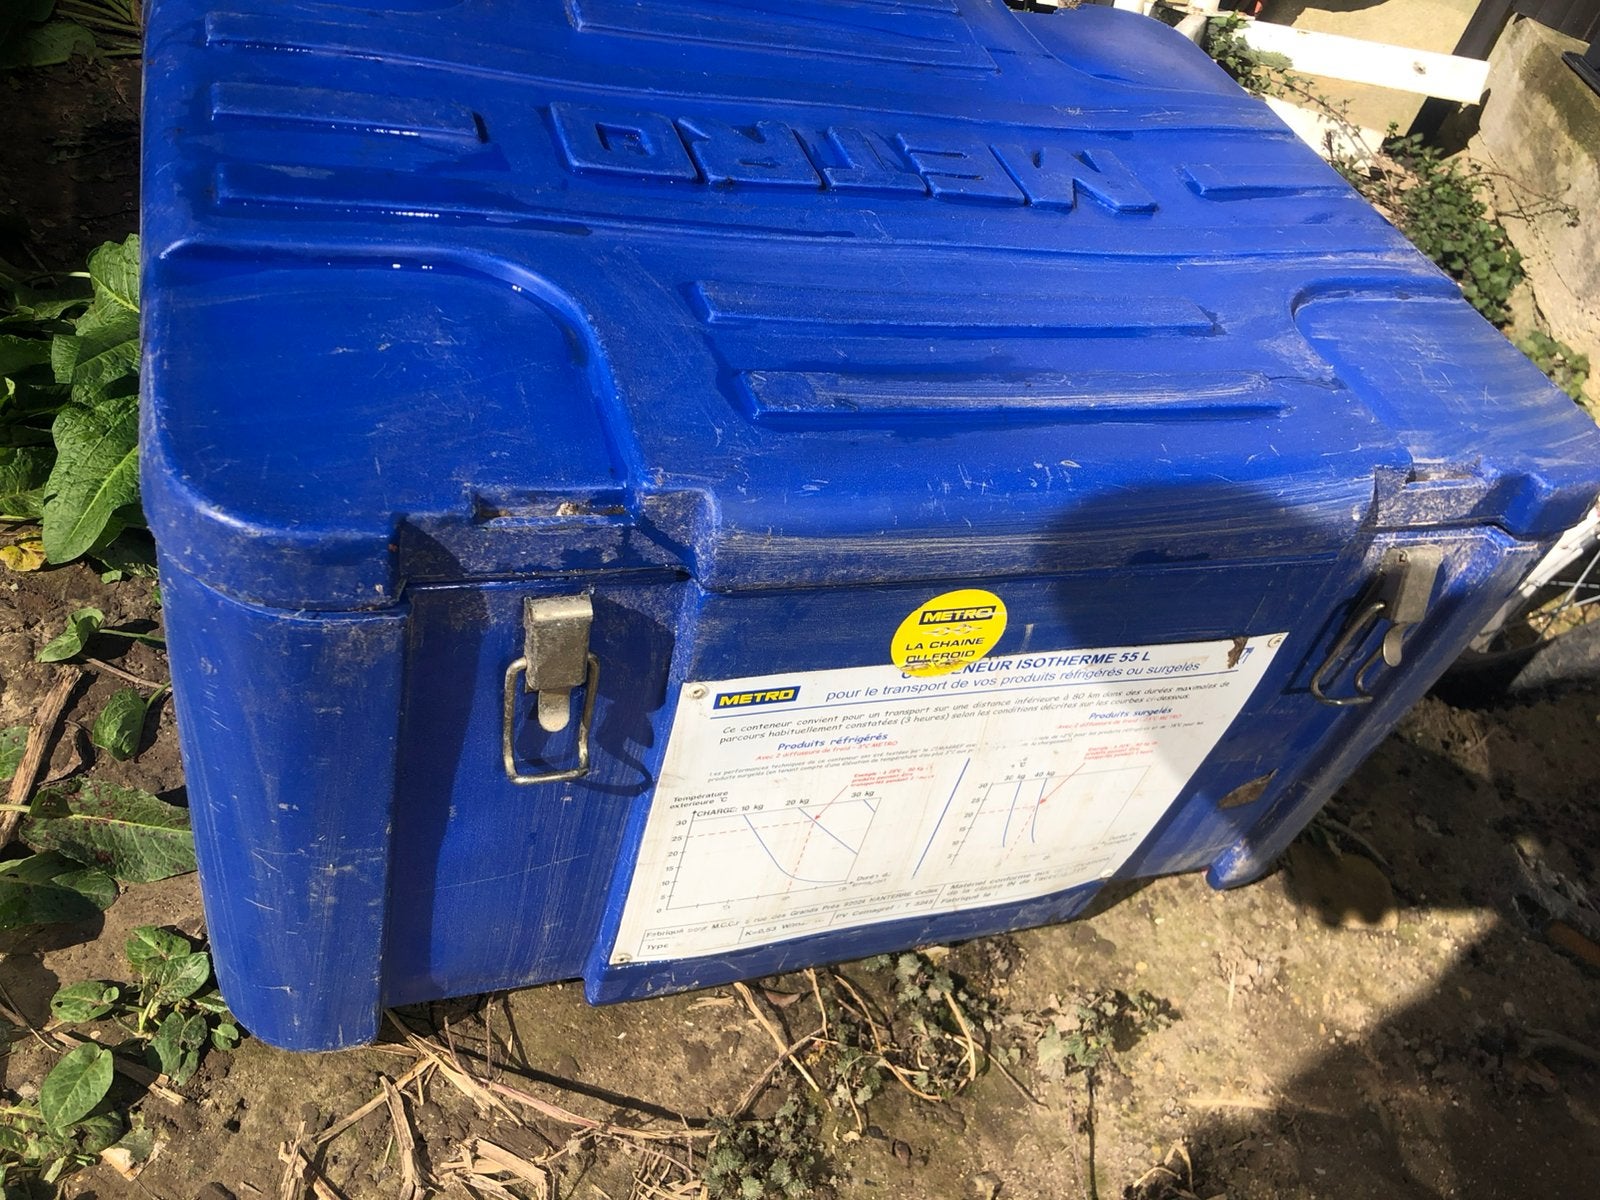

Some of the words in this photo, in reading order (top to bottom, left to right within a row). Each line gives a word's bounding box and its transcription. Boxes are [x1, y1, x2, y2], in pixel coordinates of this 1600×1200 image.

[550, 102, 1158, 214] METRO
[922, 607, 994, 623] METRO
[905, 643, 924, 651] LA
[929, 637, 985, 649] CHAINE
[1016, 652, 1117, 670] ISOTHERME
[1119, 651, 1140, 663] 55
[1142, 651, 1151, 662] L
[826, 688, 861, 702] pour
[865, 686, 878, 697] le
[882, 680, 948, 695] transport
[950, 679, 969, 689] de
[973, 679, 998, 687] vos
[1000, 671, 1057, 689] produits
[1059, 664, 1123, 681] réfrigérés
[1124, 667, 1145, 676] ou
[1145, 661, 1201, 676] surgelés
[718, 688, 796, 707] METRO
[722, 726, 736, 735] Ce
[740, 720, 793, 732] conteneur
[796, 715, 839, 727] convient
[842, 713, 866, 723] pour
[884, 706, 931, 718] transport
[934, 704, 951, 712] sur
[952, 703, 970, 711] une
[972, 699, 1012, 709] distance
[1014, 694, 1061, 705] inférieure
[1063, 693, 1071, 701] à
[1071, 692, 1086, 700] 80
[1087, 691, 1102, 699] km
[1102, 689, 1123, 698] dans
[1125, 688, 1142, 697] des
[1143, 686, 1174, 695] durées
[1218, 680, 1230, 688] de
[1088, 710, 1129, 721] Produits
[1132, 706, 1174, 717] surgelés
[719, 732, 766, 745] parcours
[768, 723, 844, 738] habituellement
[845, 718, 899, 730] constatées
[900, 716, 912, 726] (3
[913, 712, 950, 723] heures)
[951, 708, 976, 719] selon
[977, 708, 991, 717] les
[992, 704, 1039, 716] conditions
[1039, 700, 1078, 711] décrites
[1079, 700, 1095, 708] sur
[1095, 698, 1108, 706] les
[1109, 696, 1145, 706] courbes
[777, 740, 826, 751] Produits
[829, 732, 889, 746] réfrigérés
[673, 790, 730, 803] Température
[784, 799, 798, 807] 20
[798, 797, 811, 807] kg
[863, 789, 876, 799] kg
[741, 804, 751, 812] 10
[753, 803, 765, 811] kg
[675, 819, 688, 827] 30
